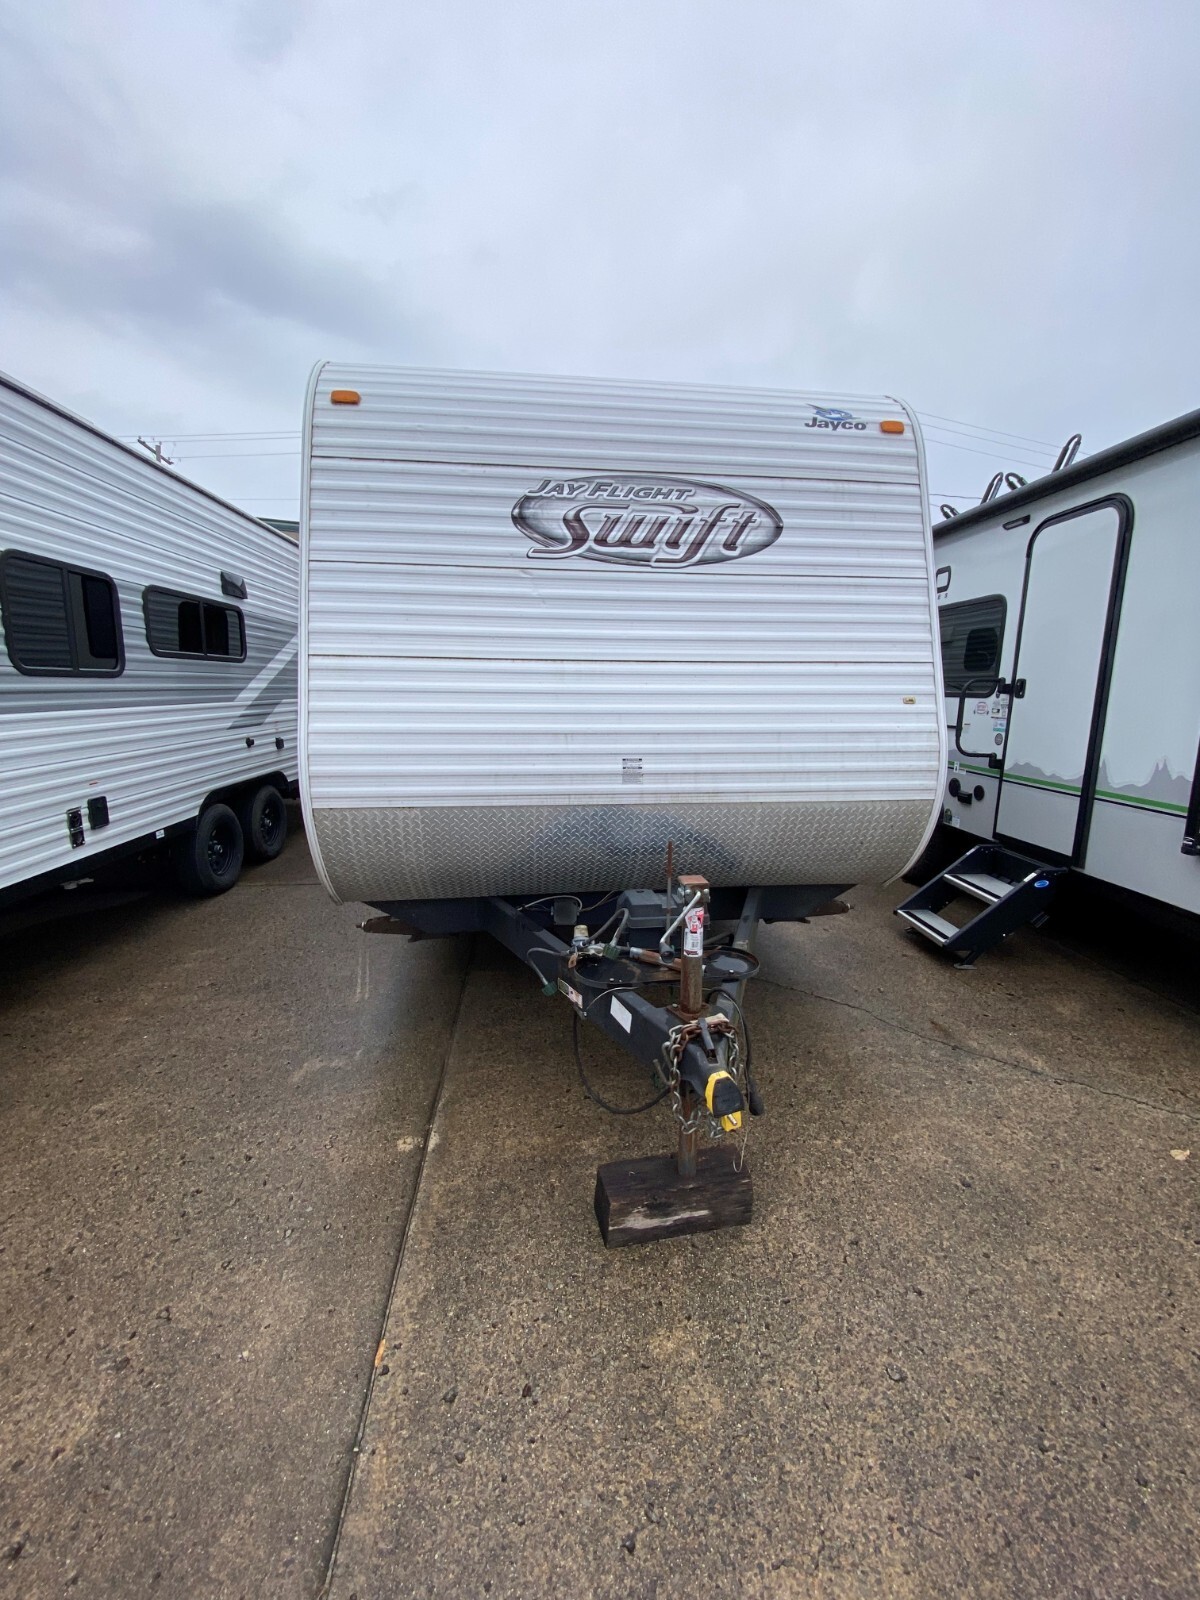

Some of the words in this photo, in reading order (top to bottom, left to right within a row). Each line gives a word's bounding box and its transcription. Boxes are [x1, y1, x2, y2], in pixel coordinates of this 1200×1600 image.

[804, 416, 867, 431] Jayco
[527, 479, 587, 496] JAY
[587, 481, 693, 500] FLIGHT
